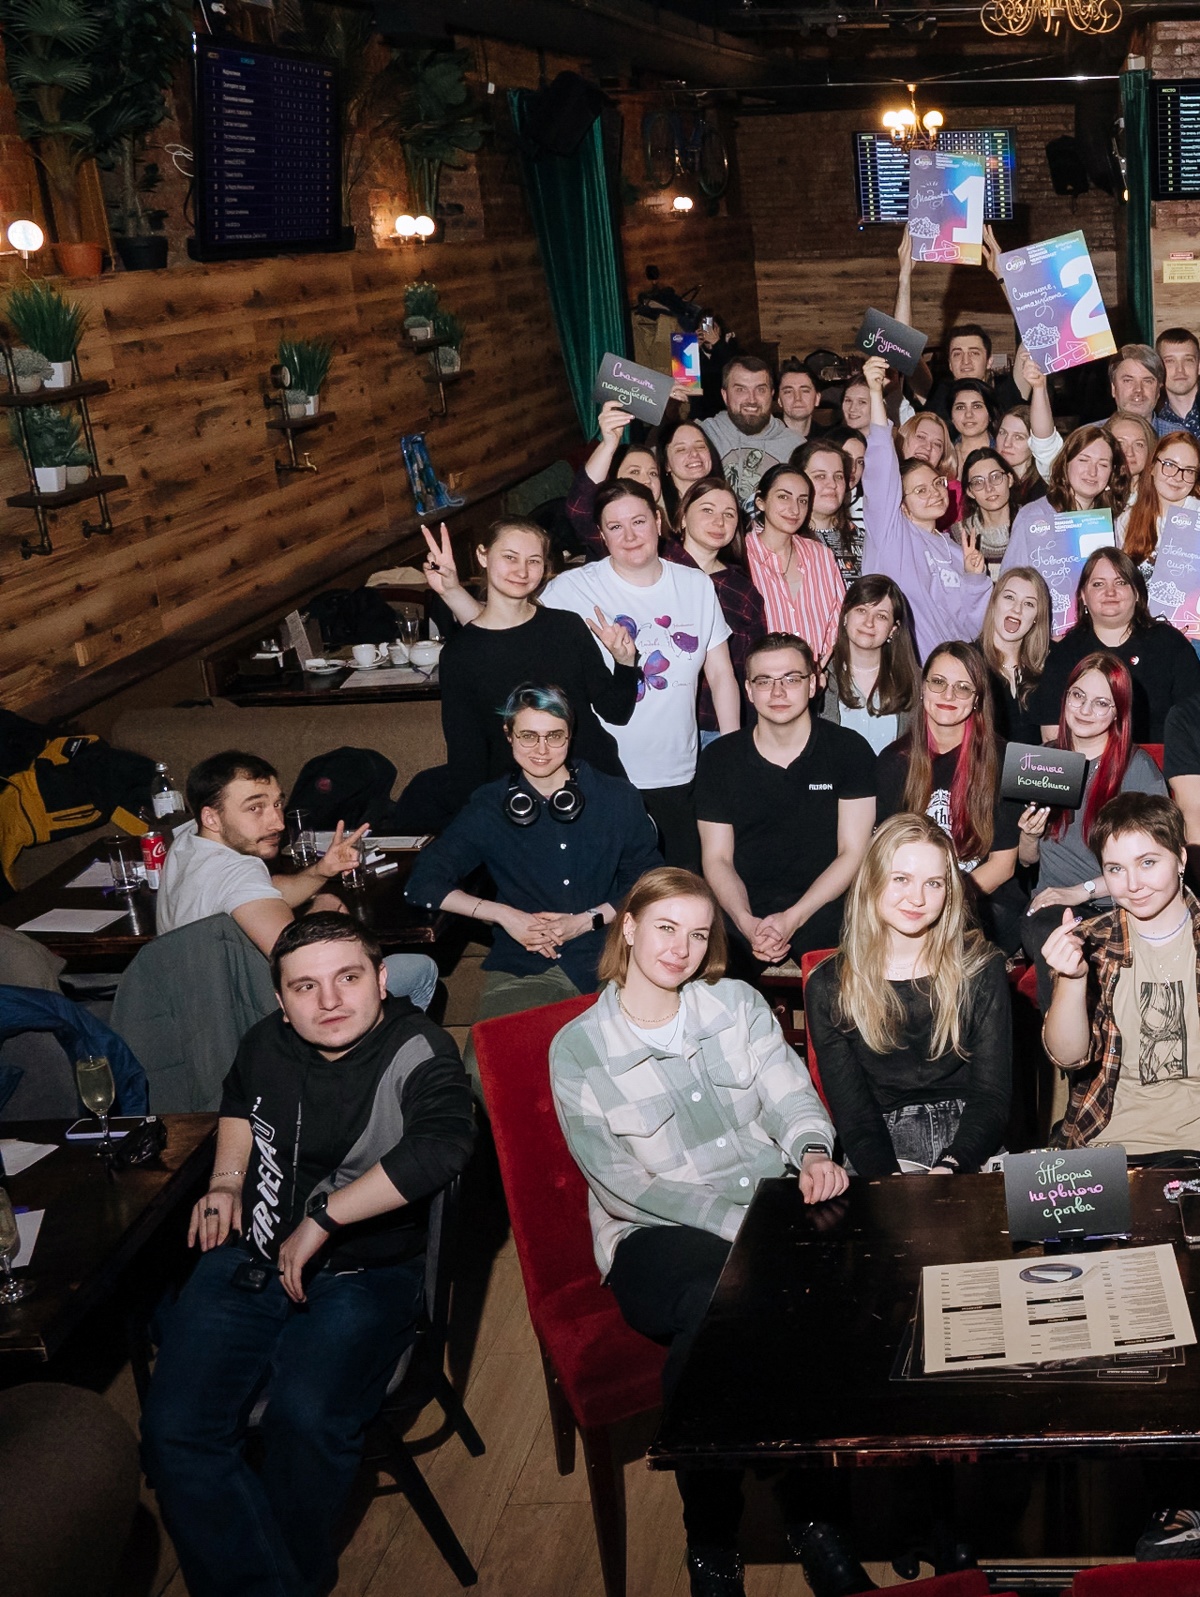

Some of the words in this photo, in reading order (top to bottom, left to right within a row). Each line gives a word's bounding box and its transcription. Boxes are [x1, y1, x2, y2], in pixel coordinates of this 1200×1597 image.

[1060, 255, 1111, 338] 2
[1035, 1158, 1092, 1189] Теория
[1029, 1183, 1103, 1206] нервного
[1043, 1196, 1095, 1223] срыва
